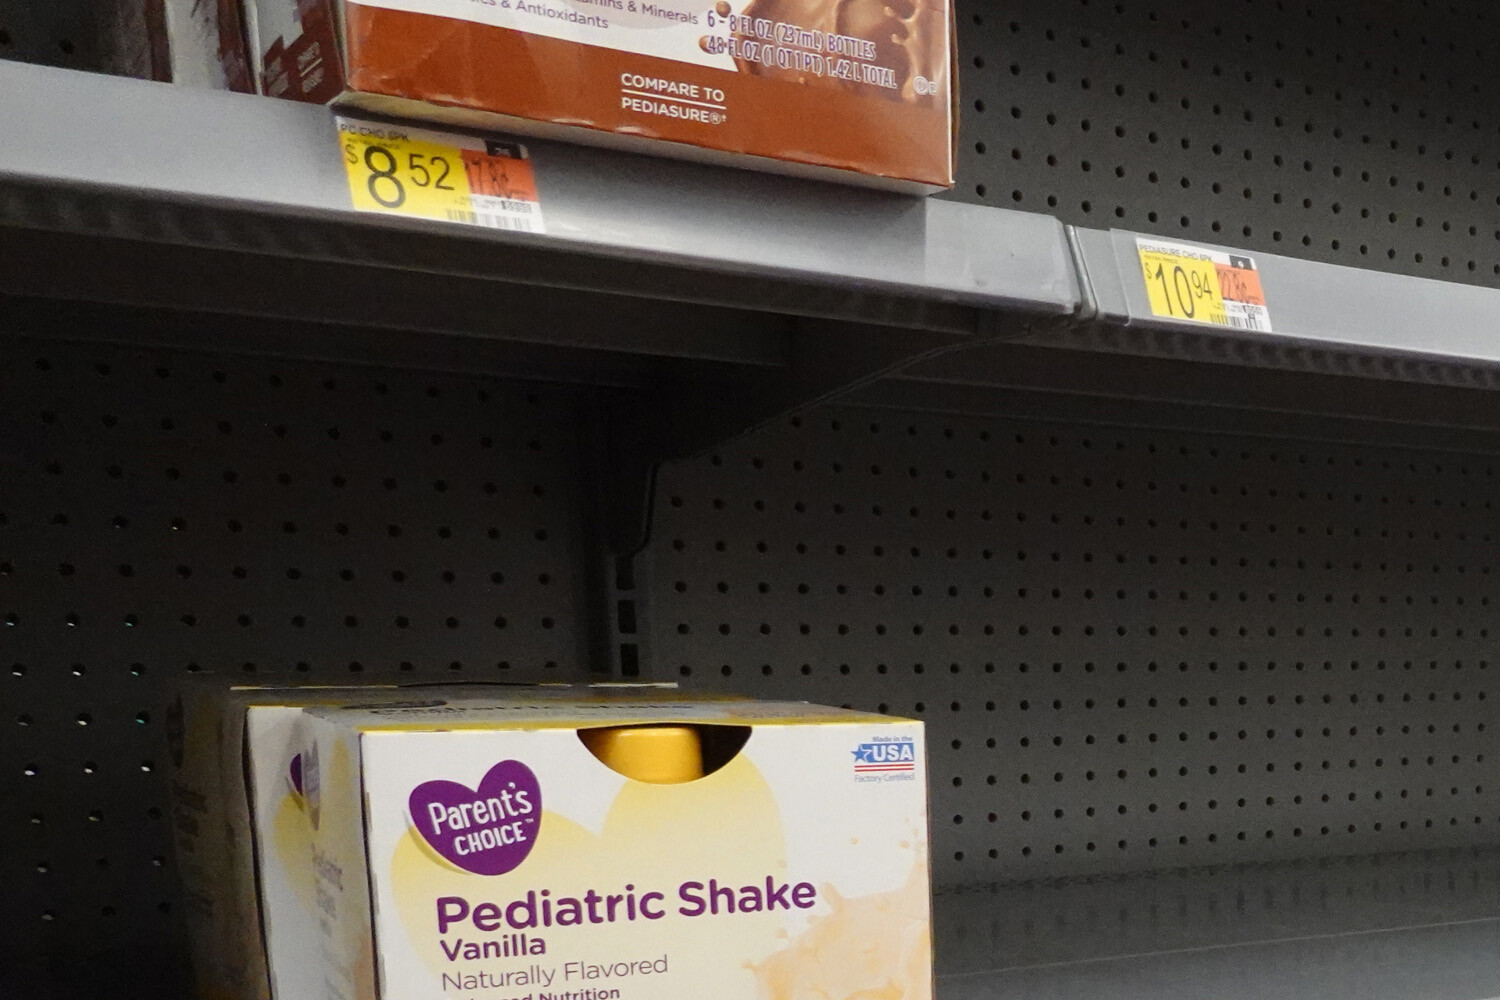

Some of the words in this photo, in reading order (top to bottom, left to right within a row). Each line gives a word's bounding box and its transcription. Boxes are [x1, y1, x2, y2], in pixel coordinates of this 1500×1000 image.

[516, 1, 609, 29] Antioxidants
[642, 5, 699, 25] Minerals
[707, 14, 716, 28] 6
[729, 16, 738, 32] 8
[827, 36, 876, 61] BOTTLES
[707, 35, 725, 55] 48
[861, 65, 898, 90] TOTAL
[621, 73, 699, 98] COMPARE
[703, 87, 725, 102] TO
[872, 744, 914, 762] USA
[428, 780, 533, 836] Parent's
[454, 821, 527, 857] CHOICE
[437, 883, 666, 935] Pediatric
[679, 876, 817, 918] Shake
[440, 932, 547, 963] Vanilla
[442, 964, 556, 992] Naturally
[563, 954, 669, 981] Flavored
